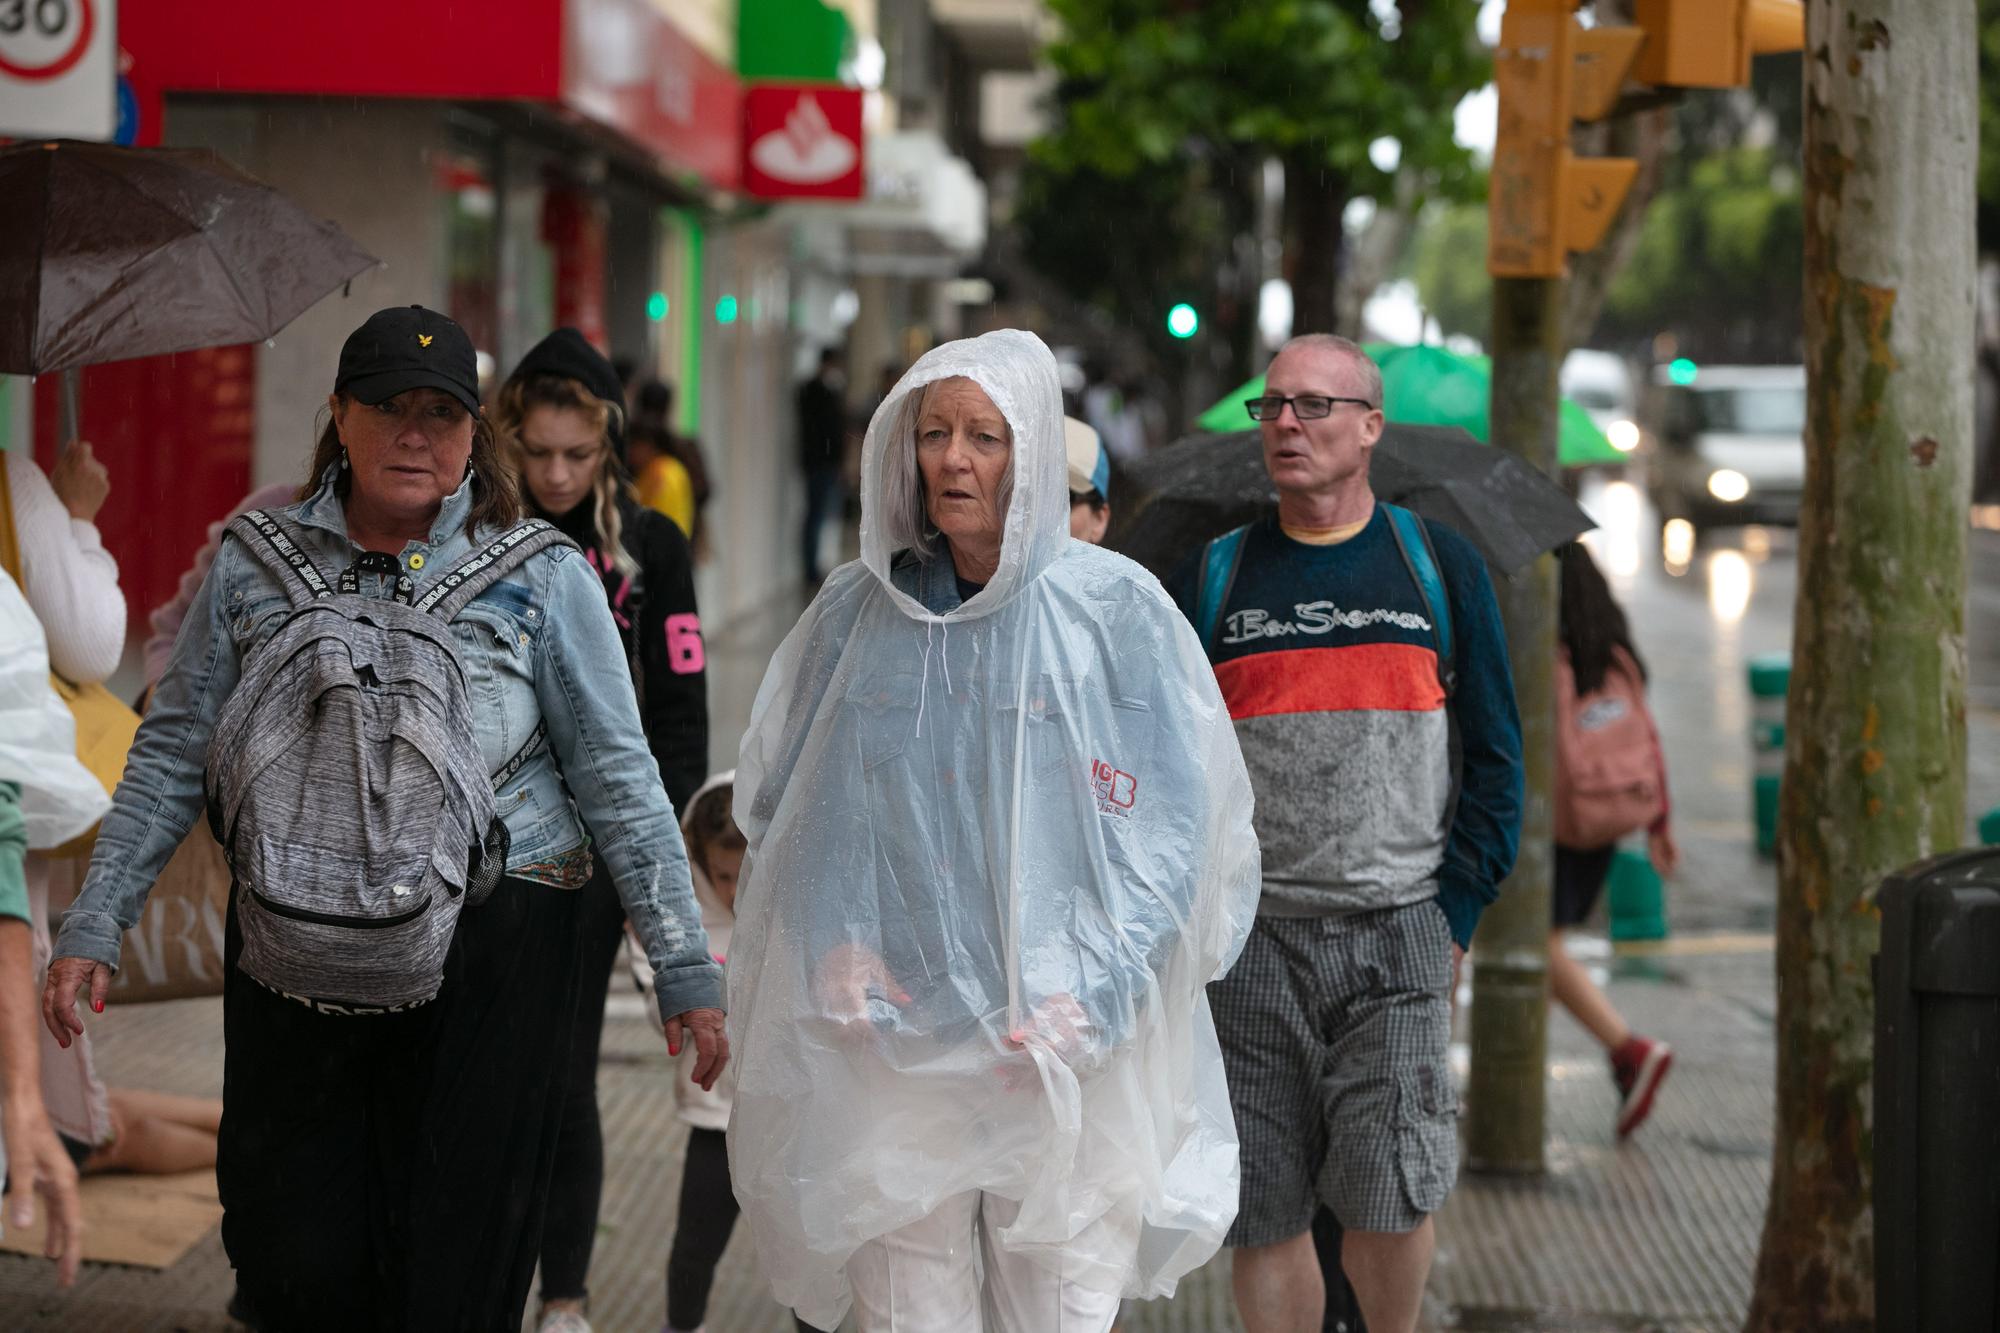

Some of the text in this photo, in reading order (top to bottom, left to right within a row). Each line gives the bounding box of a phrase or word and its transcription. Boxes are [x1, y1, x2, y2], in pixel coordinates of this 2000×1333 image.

[0, 0, 67, 35] 30
[501, 525, 537, 547] PINK
[298, 563, 327, 591] PINK
[457, 553, 493, 577] PINK
[1223, 600, 1432, 644] Ben Sherman
[665, 612, 704, 675] 6
[1092, 759, 1112, 781] IG
